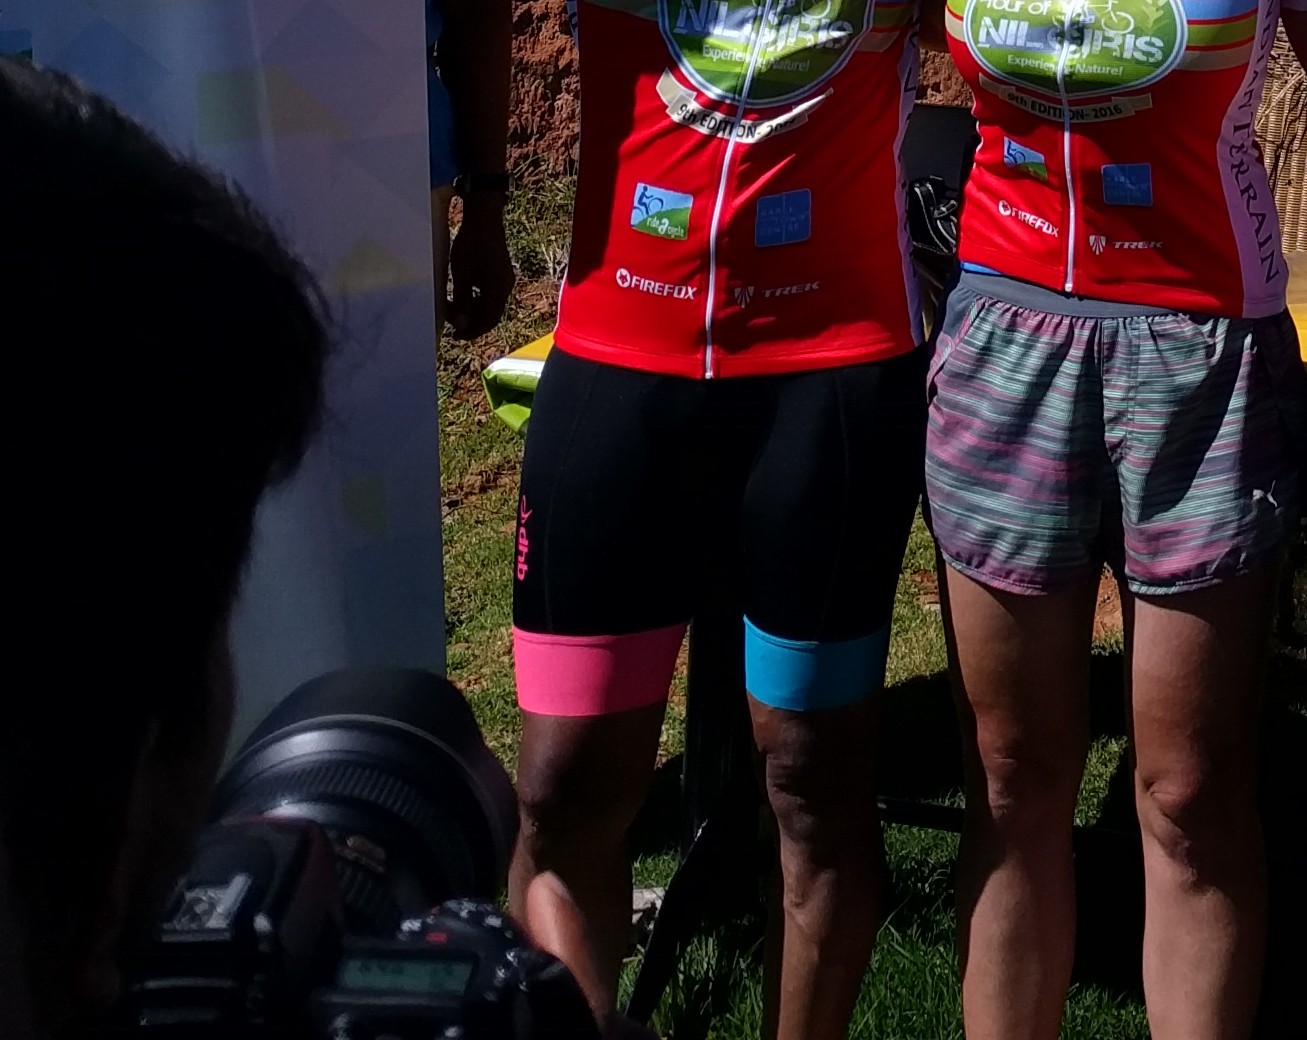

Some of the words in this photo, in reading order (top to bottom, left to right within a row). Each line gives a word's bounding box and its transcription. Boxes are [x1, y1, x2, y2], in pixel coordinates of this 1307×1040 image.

[1028, 0, 1052, 16] of
[703, 44, 766, 69] Experien
[1007, 54, 1073, 74] Experiene
[676, 103, 698, 124] 9th
[1006, 91, 1028, 108] 9th
[1092, 103, 1123, 120] 2016
[1011, 206, 1059, 238] FIREFOX
[1112, 240, 1164, 250] TREK
[631, 276, 698, 301] FIREFOX
[763, 280, 820, 298] TREK
